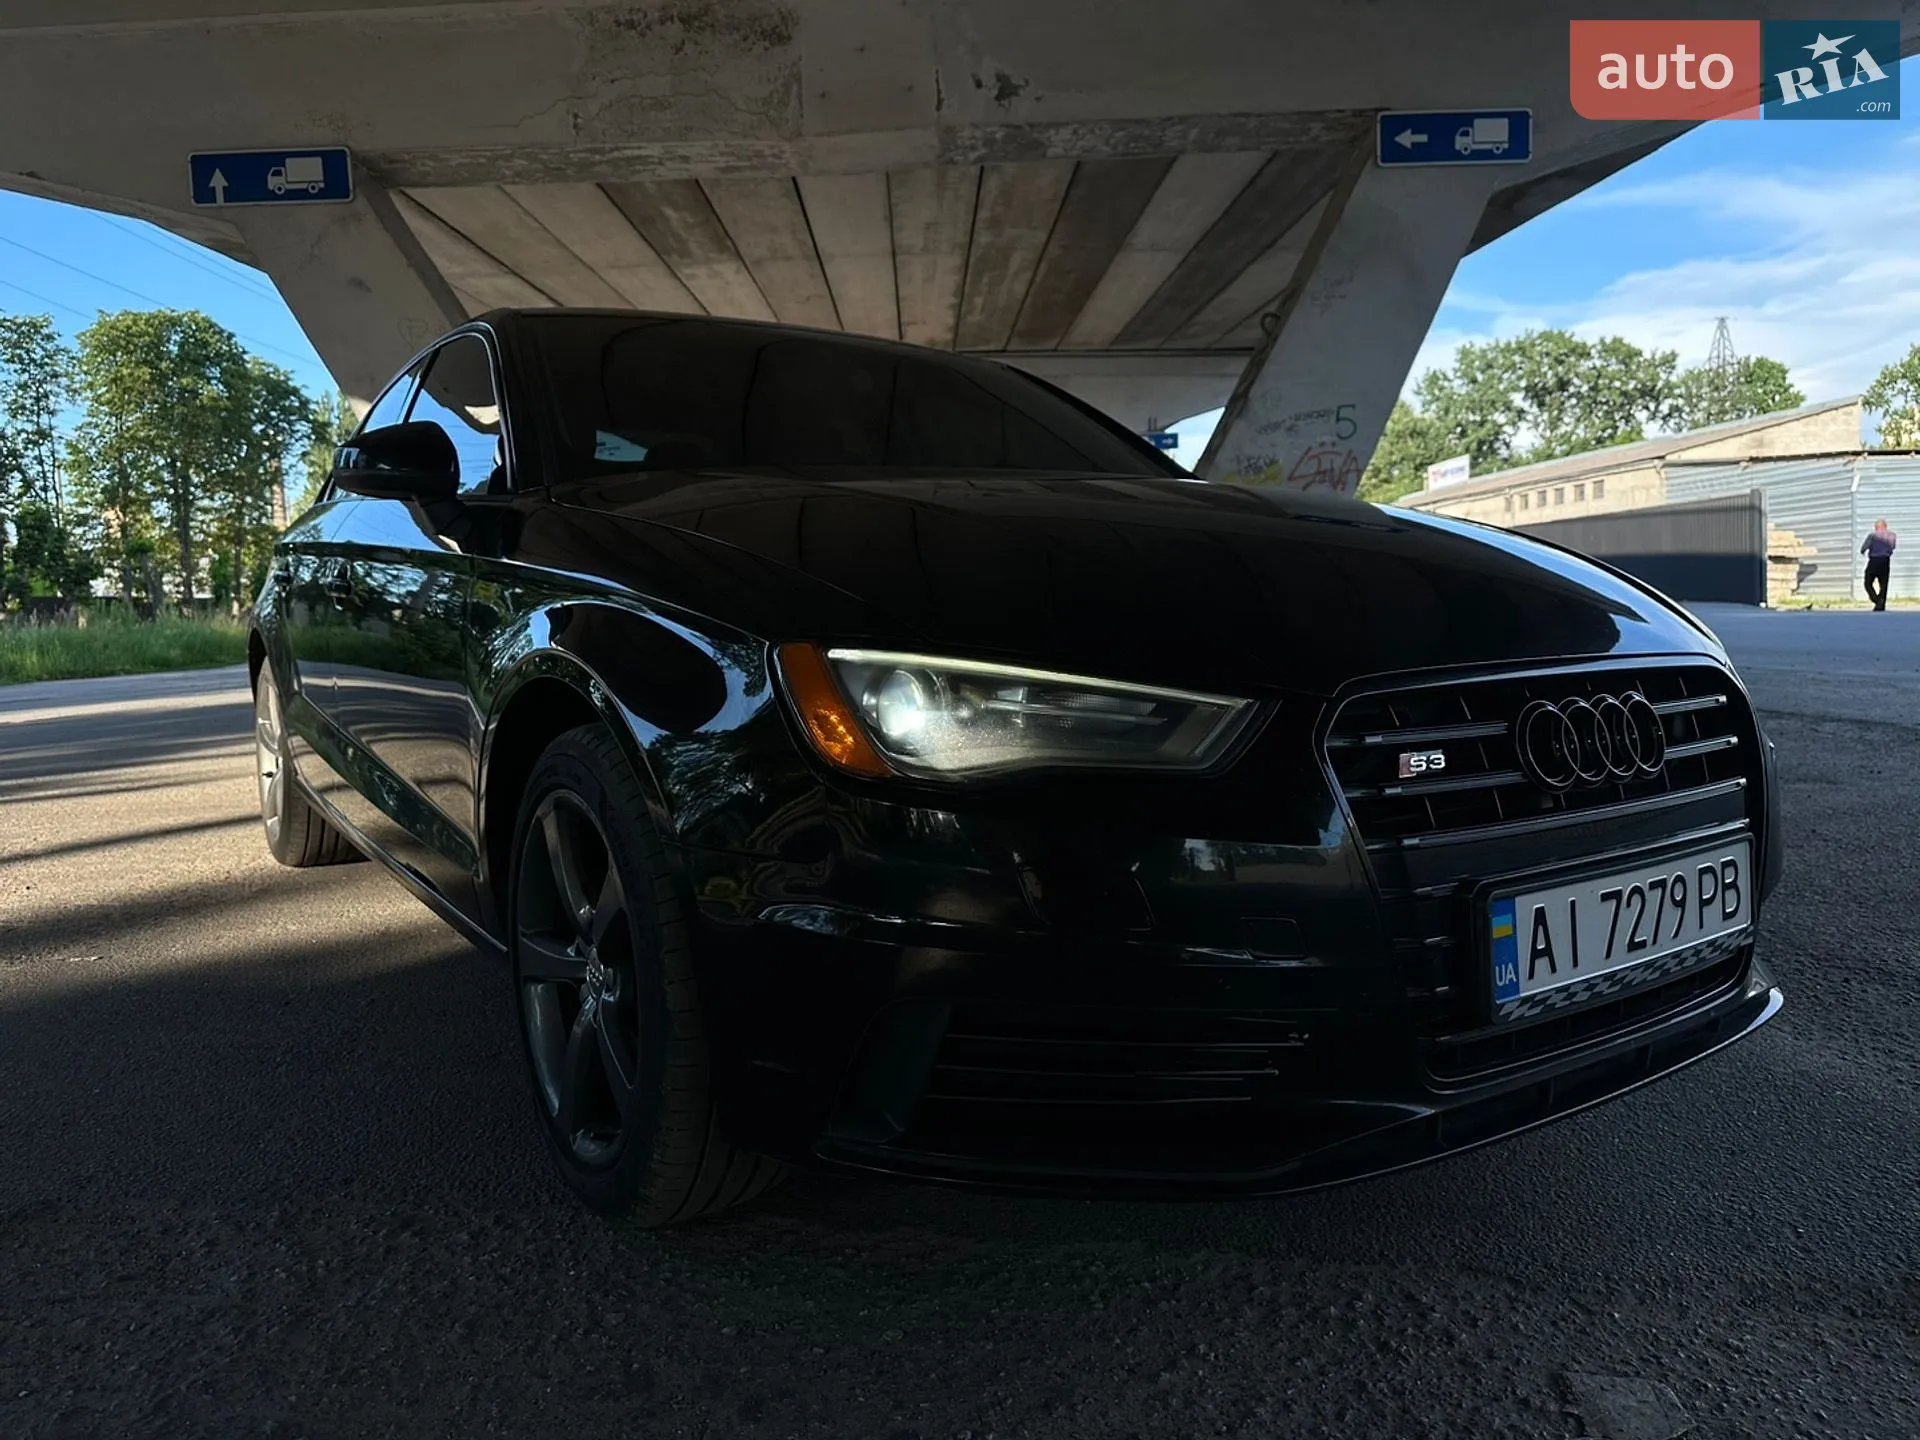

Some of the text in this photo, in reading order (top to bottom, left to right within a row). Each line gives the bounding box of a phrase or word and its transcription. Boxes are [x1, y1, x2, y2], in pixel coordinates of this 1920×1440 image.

[1336, 404, 1358, 440] 5
[1410, 754, 1446, 771] S3
[1527, 856, 1742, 981] AI 7279 PB
[1495, 963, 1517, 987] UA
